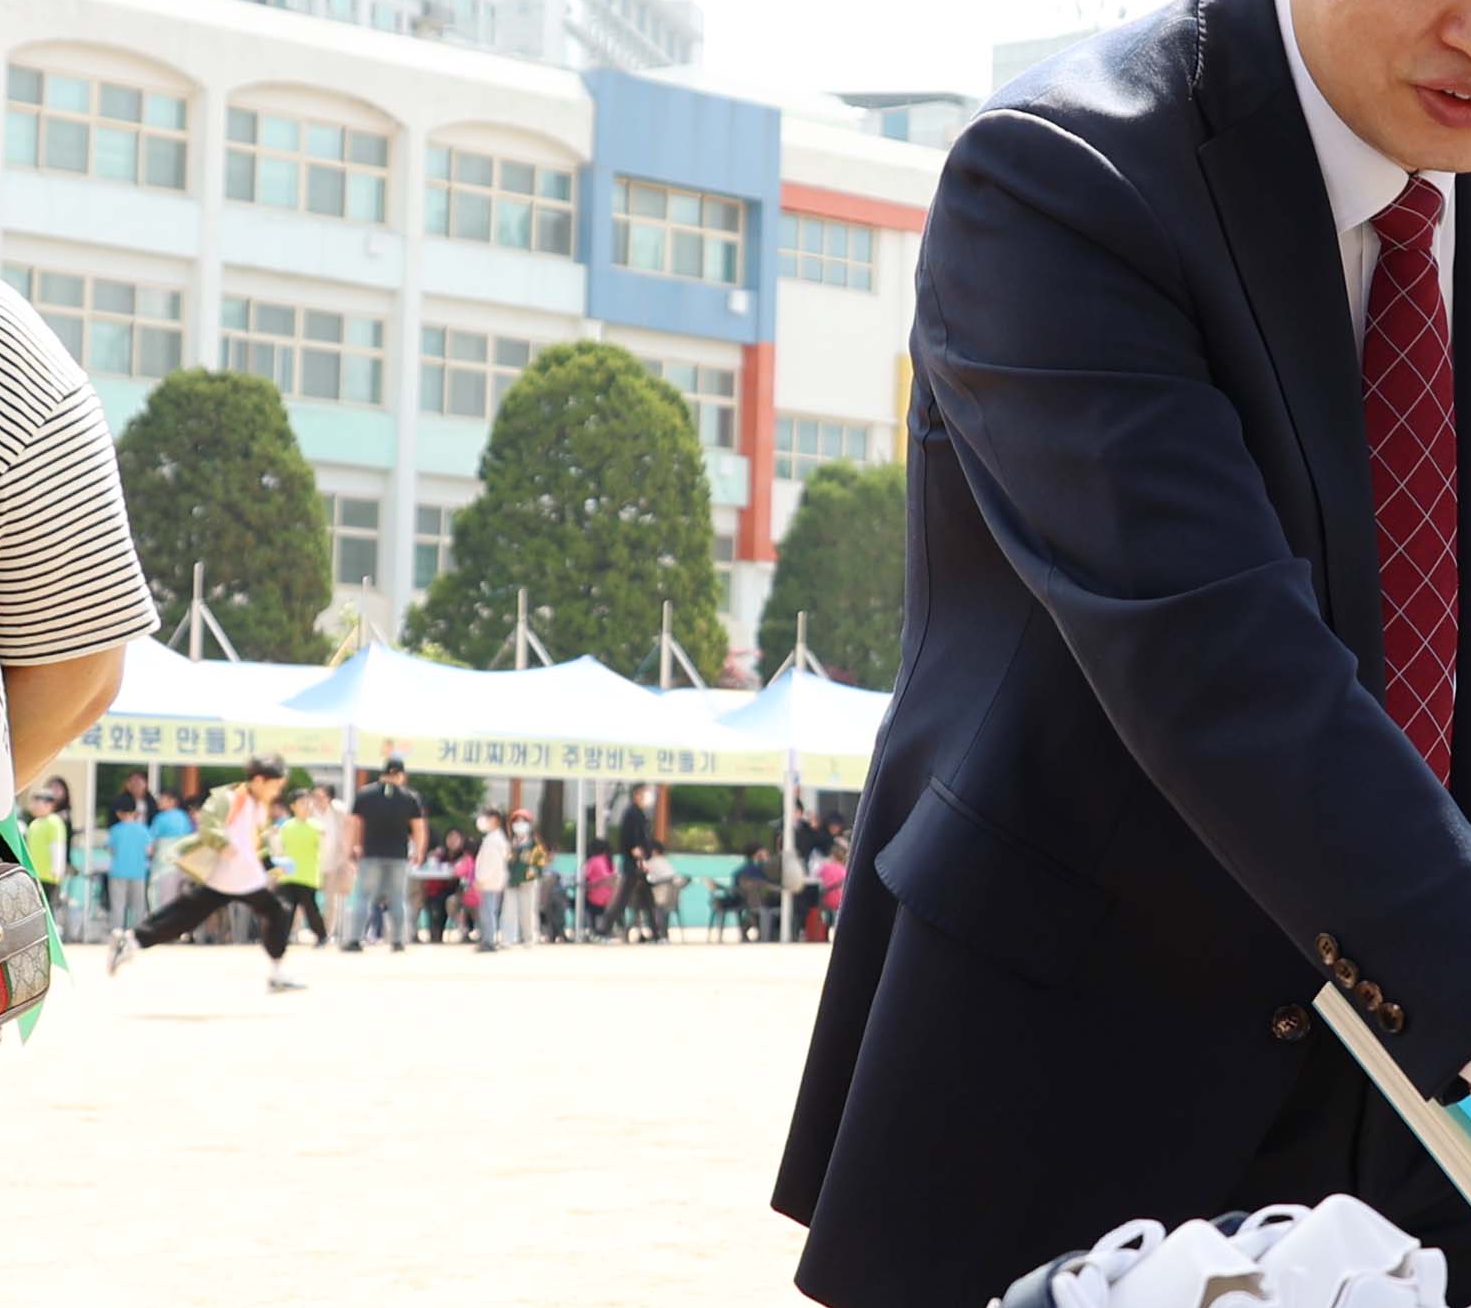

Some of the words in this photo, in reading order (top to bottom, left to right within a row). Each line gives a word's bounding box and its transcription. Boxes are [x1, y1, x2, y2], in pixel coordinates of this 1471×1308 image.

[66, 723, 163, 753] 육화분
[176, 726, 256, 755] 만들기
[563, 746, 646, 771] 주방비누
[656, 749, 716, 774] 만들기
